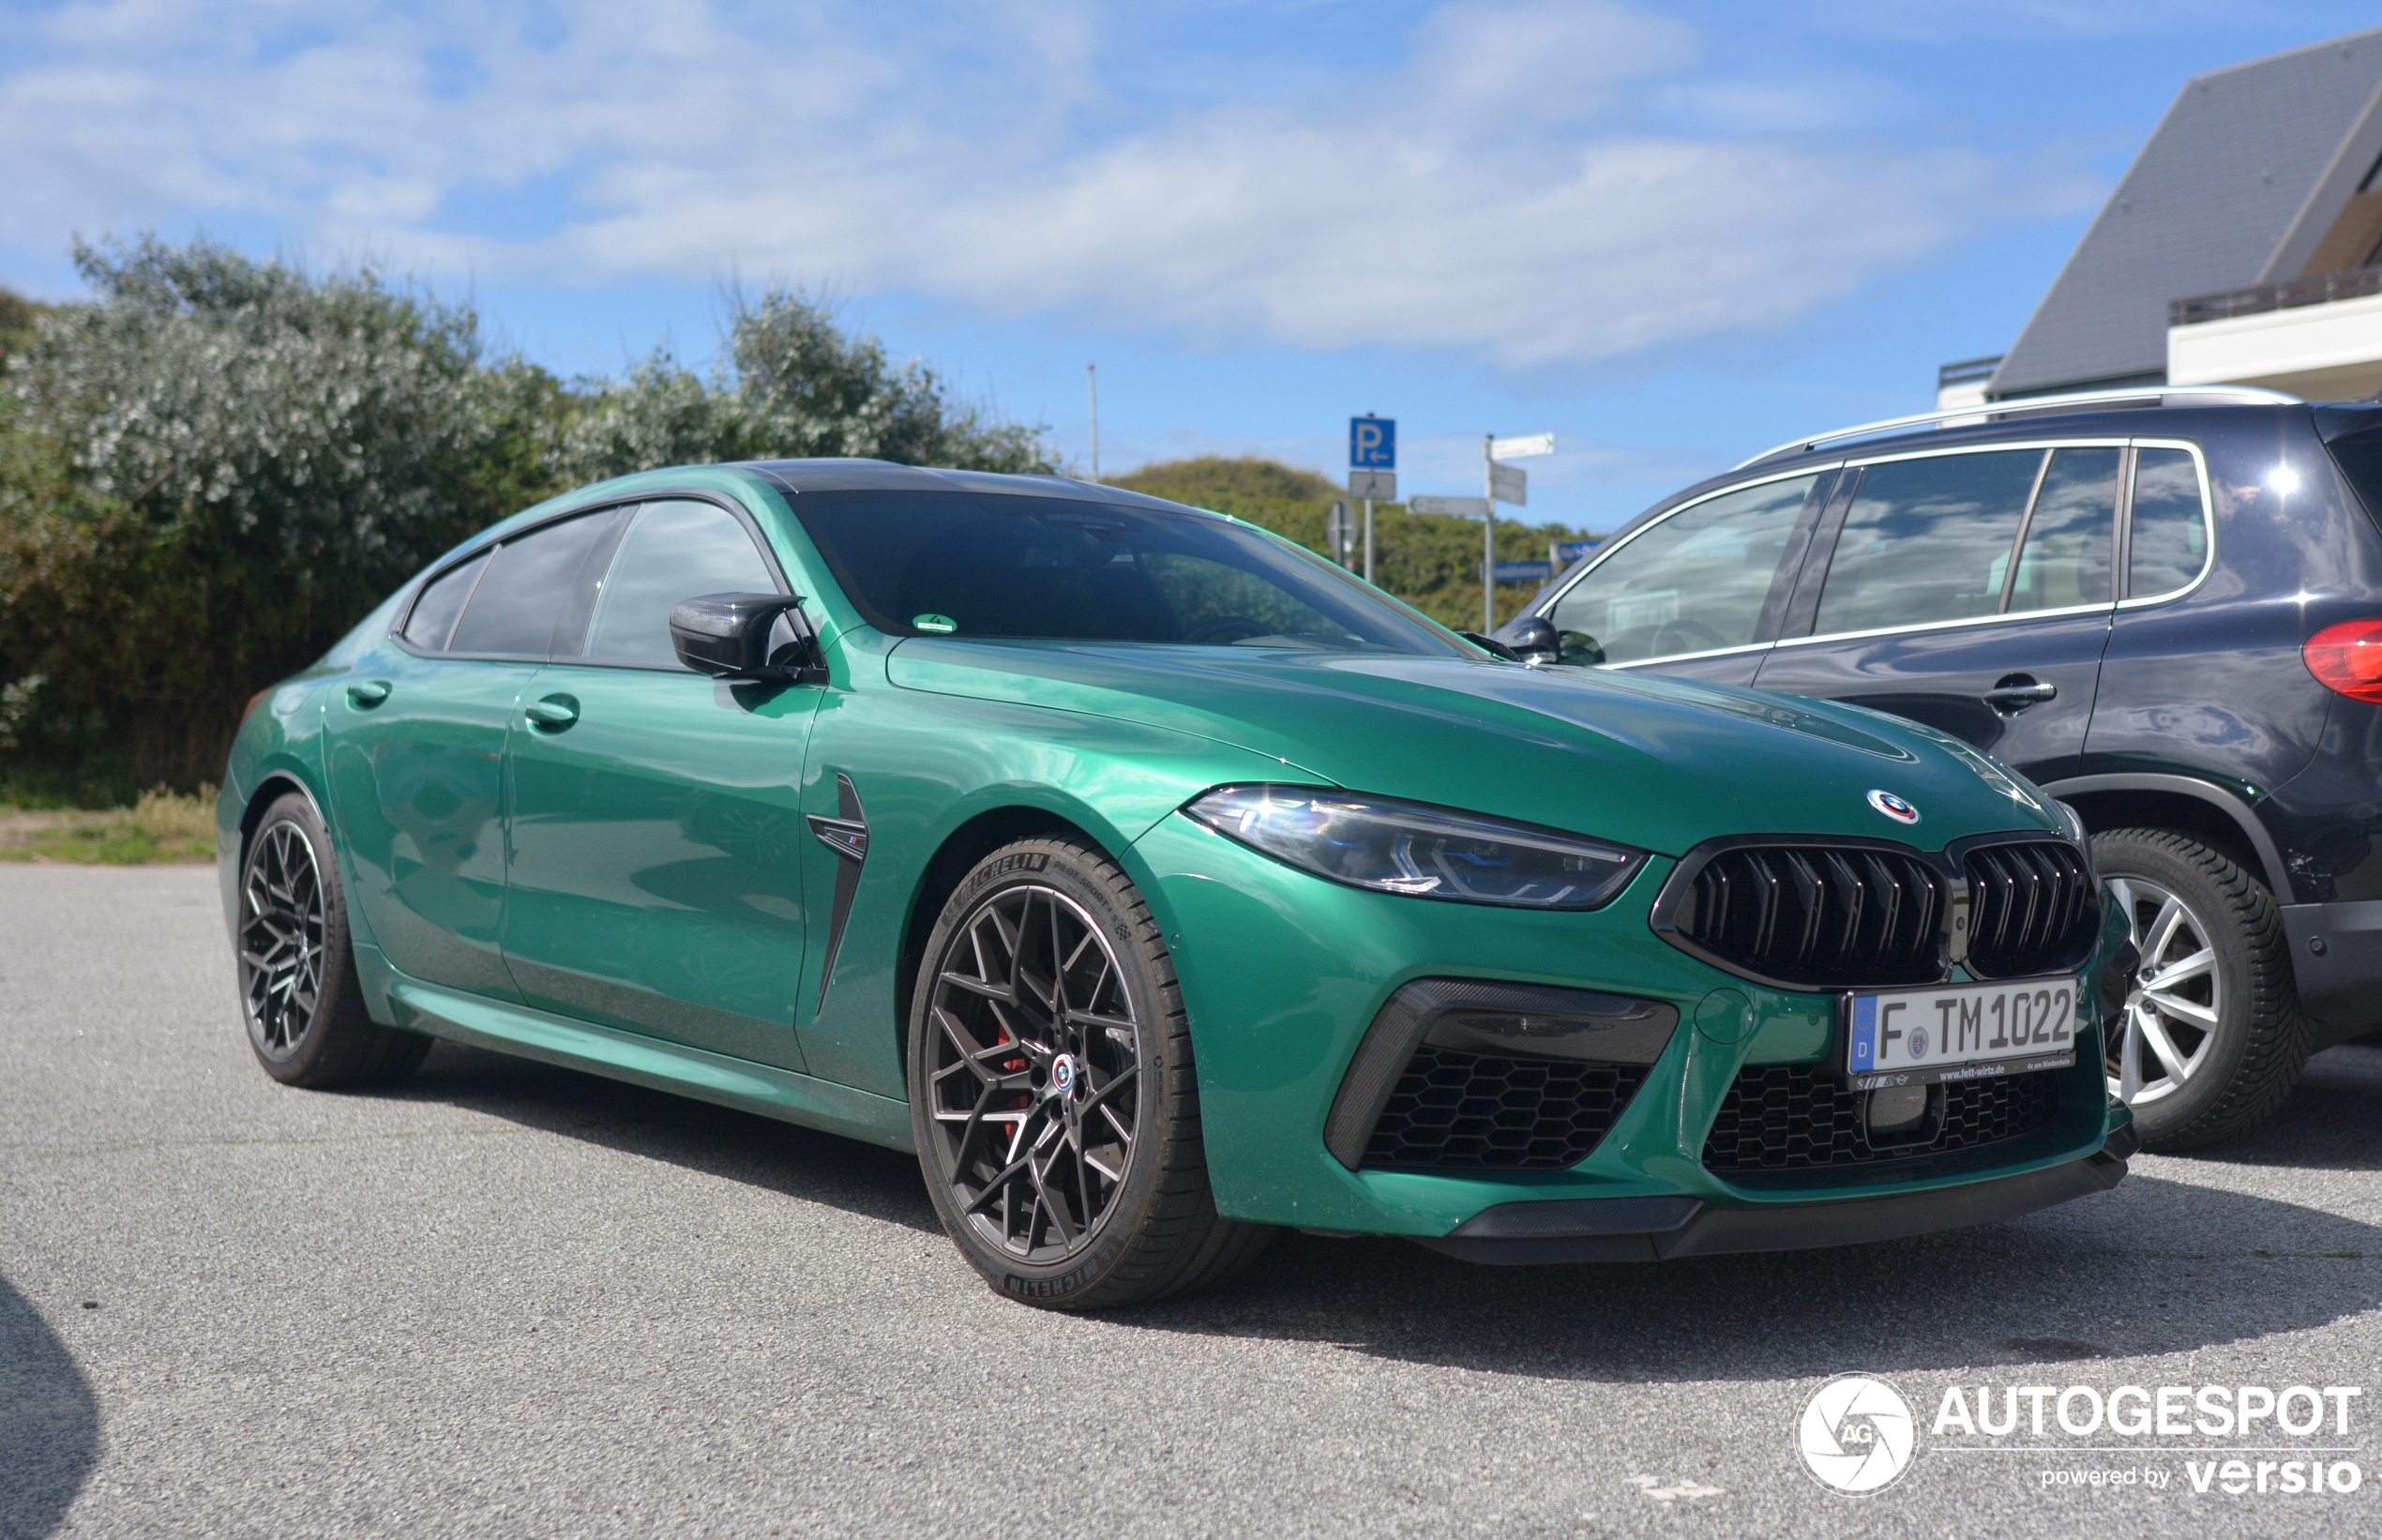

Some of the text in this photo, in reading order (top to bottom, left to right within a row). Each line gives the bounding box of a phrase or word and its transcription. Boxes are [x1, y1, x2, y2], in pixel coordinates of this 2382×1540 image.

[1356, 424, 1382, 462] P
[958, 853, 1044, 902] MICHELIN
[1053, 860, 1079, 881] PILOT
[1079, 877, 1108, 908] SPORT
[1879, 989, 2071, 1059] F TM 1022
[1857, 1041, 1867, 1058] D
[2042, 1058, 2071, 1068] Niederrhein
[1009, 1258, 1099, 1296] MICHELIN
